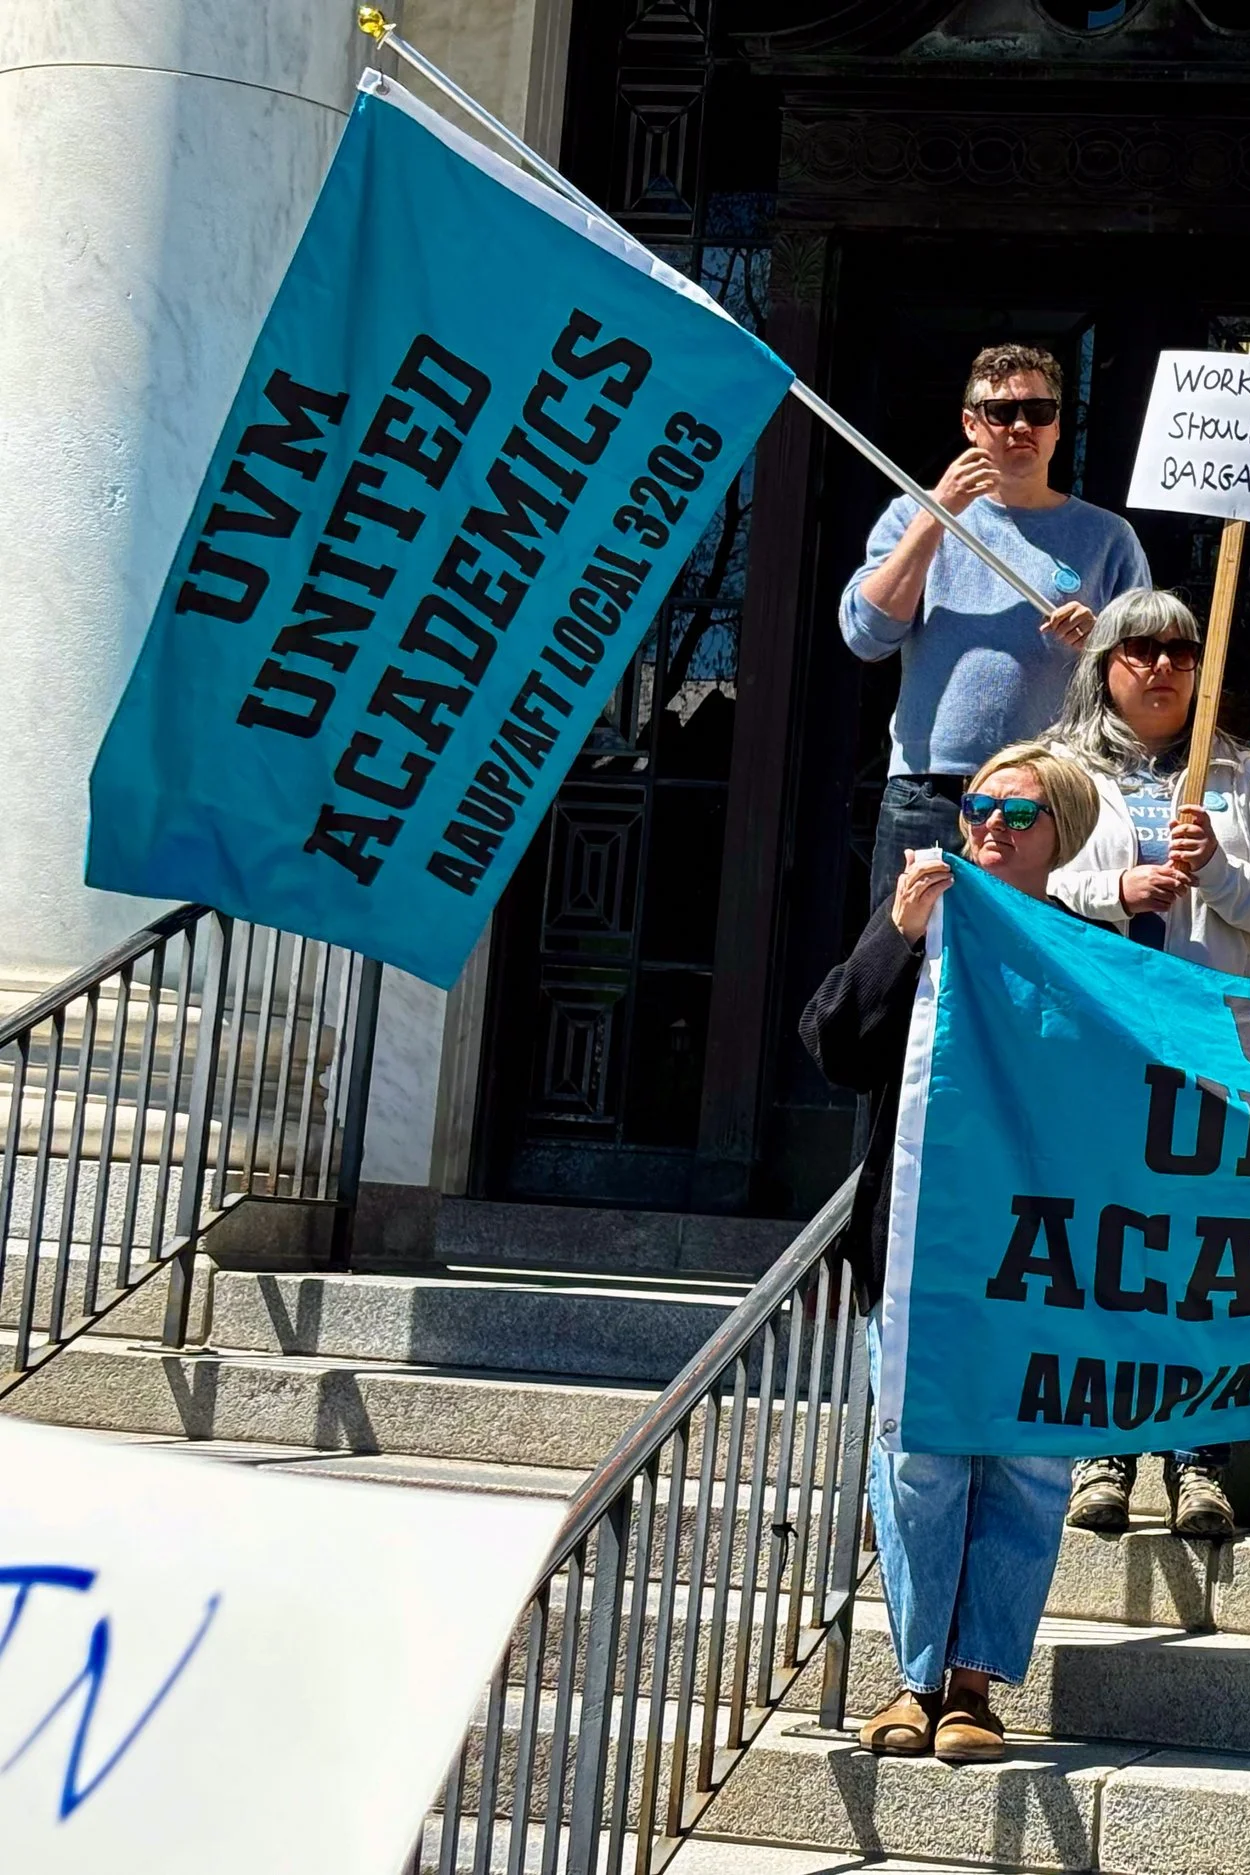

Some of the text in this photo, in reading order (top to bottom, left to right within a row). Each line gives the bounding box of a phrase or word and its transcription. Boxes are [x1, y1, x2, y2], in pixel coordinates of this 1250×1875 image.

[174, 369, 351, 624] UVM
[236, 334, 492, 739] UNITED
[303, 308, 653, 887] ACADEMICS
[426, 411, 723, 896] AAUP/AFT LOCAL 3203
